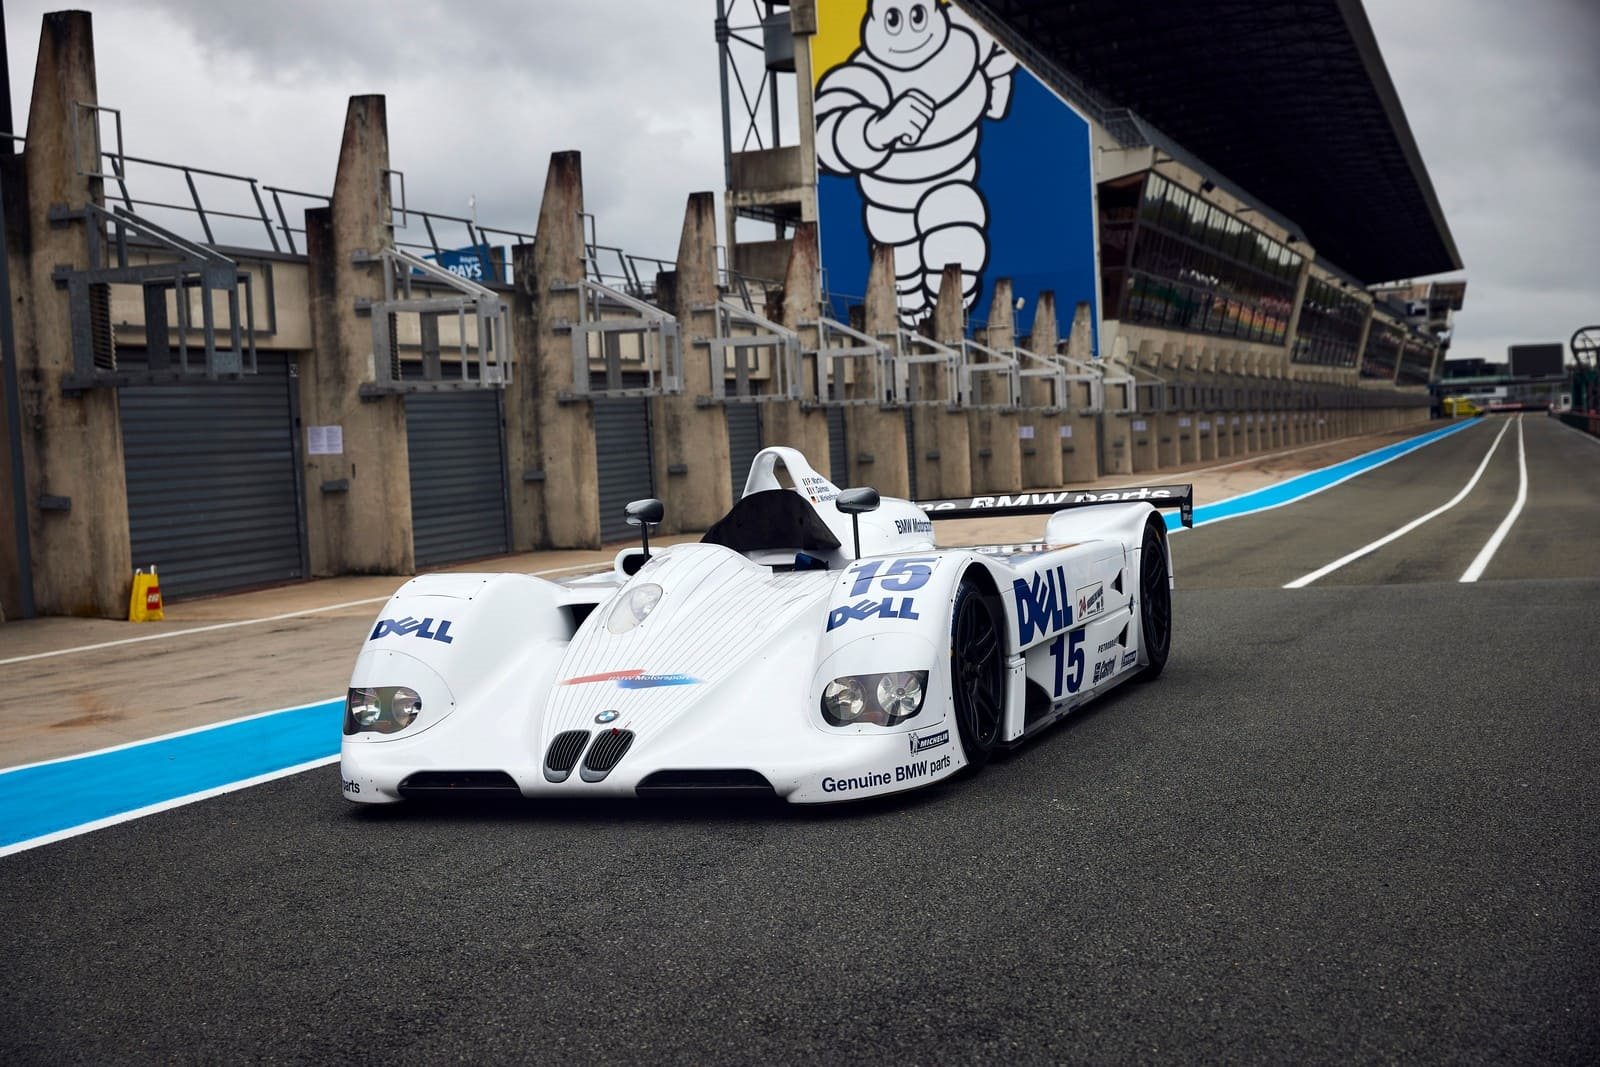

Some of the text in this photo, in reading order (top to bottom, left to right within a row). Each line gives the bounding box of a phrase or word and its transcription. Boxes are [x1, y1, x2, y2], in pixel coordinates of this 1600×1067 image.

[969, 492, 1069, 509] BMW
[894, 518, 912, 534] BMW
[848, 558, 938, 597] 15
[826, 597, 920, 632] DELL
[1013, 565, 1073, 647] DELL
[369, 616, 454, 644] DELL
[1049, 629, 1086, 698] 15
[342, 779, 360, 793] arts
[821, 754, 951, 793] Genuine BMW parts
